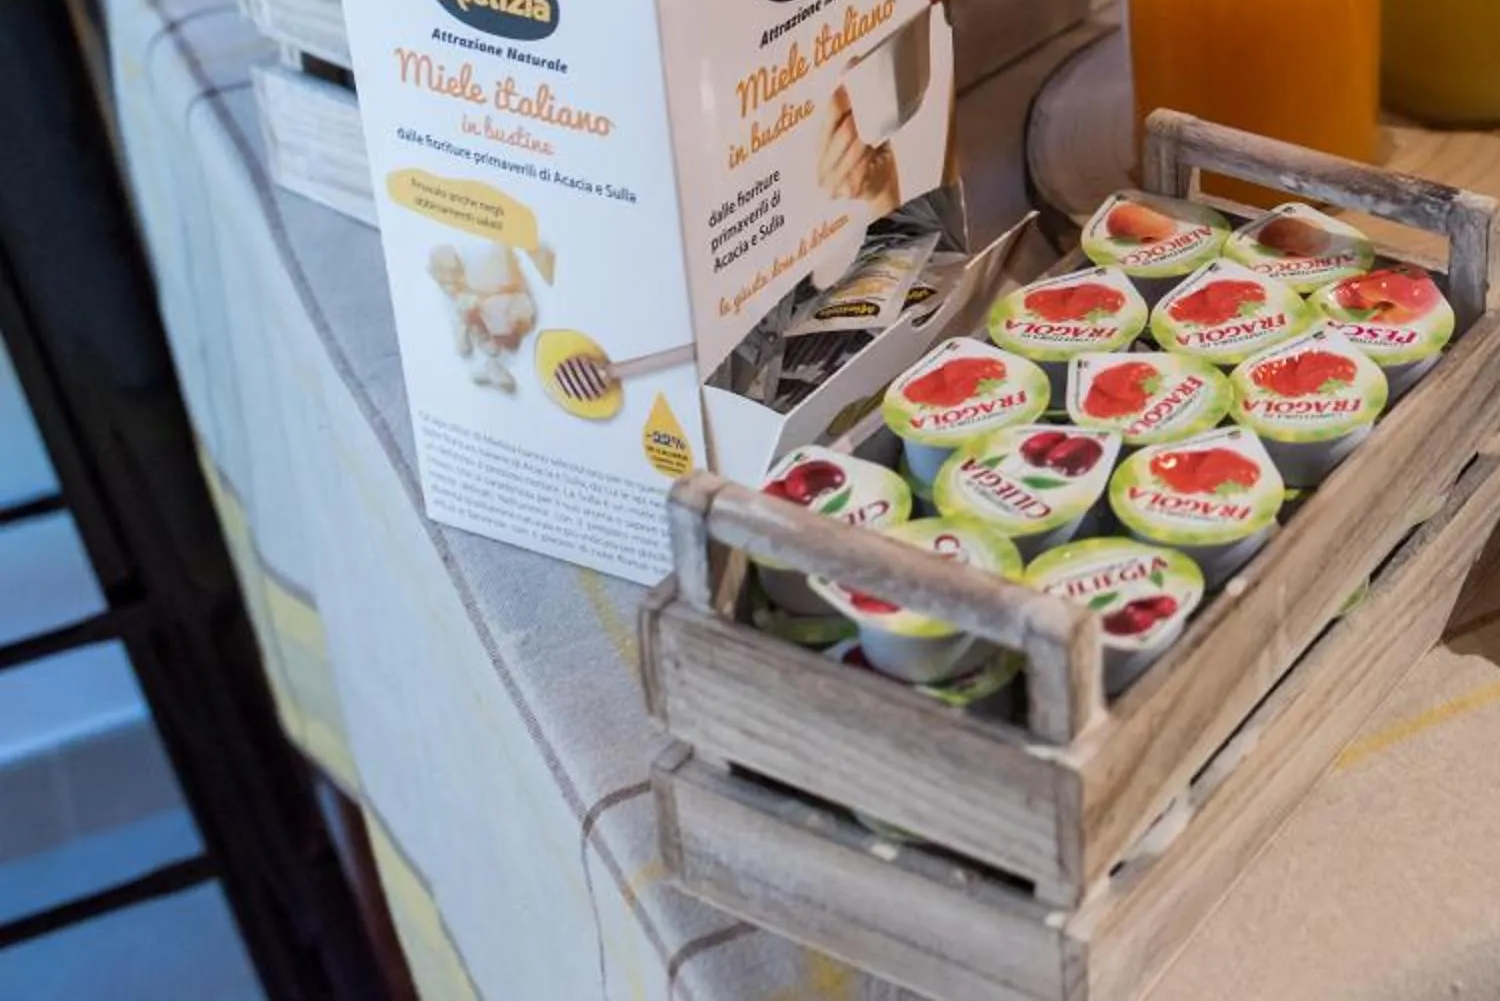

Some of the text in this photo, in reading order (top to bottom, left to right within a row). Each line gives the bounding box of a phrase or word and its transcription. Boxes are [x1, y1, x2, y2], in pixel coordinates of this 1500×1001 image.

[760, 0, 822, 48] Attrazione
[431, 27, 568, 74] Attrazione Naturale
[394, 47, 616, 137] Miele italiano
[736, 43, 810, 119] Miele
[461, 114, 556, 156] in bustine
[728, 99, 815, 170] in bustine
[538, 167, 551, 181] di
[553, 171, 593, 192] Acacia
[595, 184, 603, 196] e
[605, 184, 638, 204] Sulla
[708, 170, 781, 228] dalle fioriture
[711, 190, 781, 254] primaverili di
[714, 214, 785, 273] Acacia e Sulla
[1117, 226, 1213, 265] ALBICOCCA
[1005, 318, 1119, 339] FRAGOLA
[1175, 313, 1287, 346] FRAGOLA
[1327, 320, 1417, 344] PESCA
[909, 390, 1028, 429] FRAGOLA
[1124, 374, 1204, 435] FRAGOLA
[1242, 398, 1362, 414] FRAGOLA
[958, 458, 1051, 519] CILIEGIA
[1127, 486, 1252, 521] FRAGOLA
